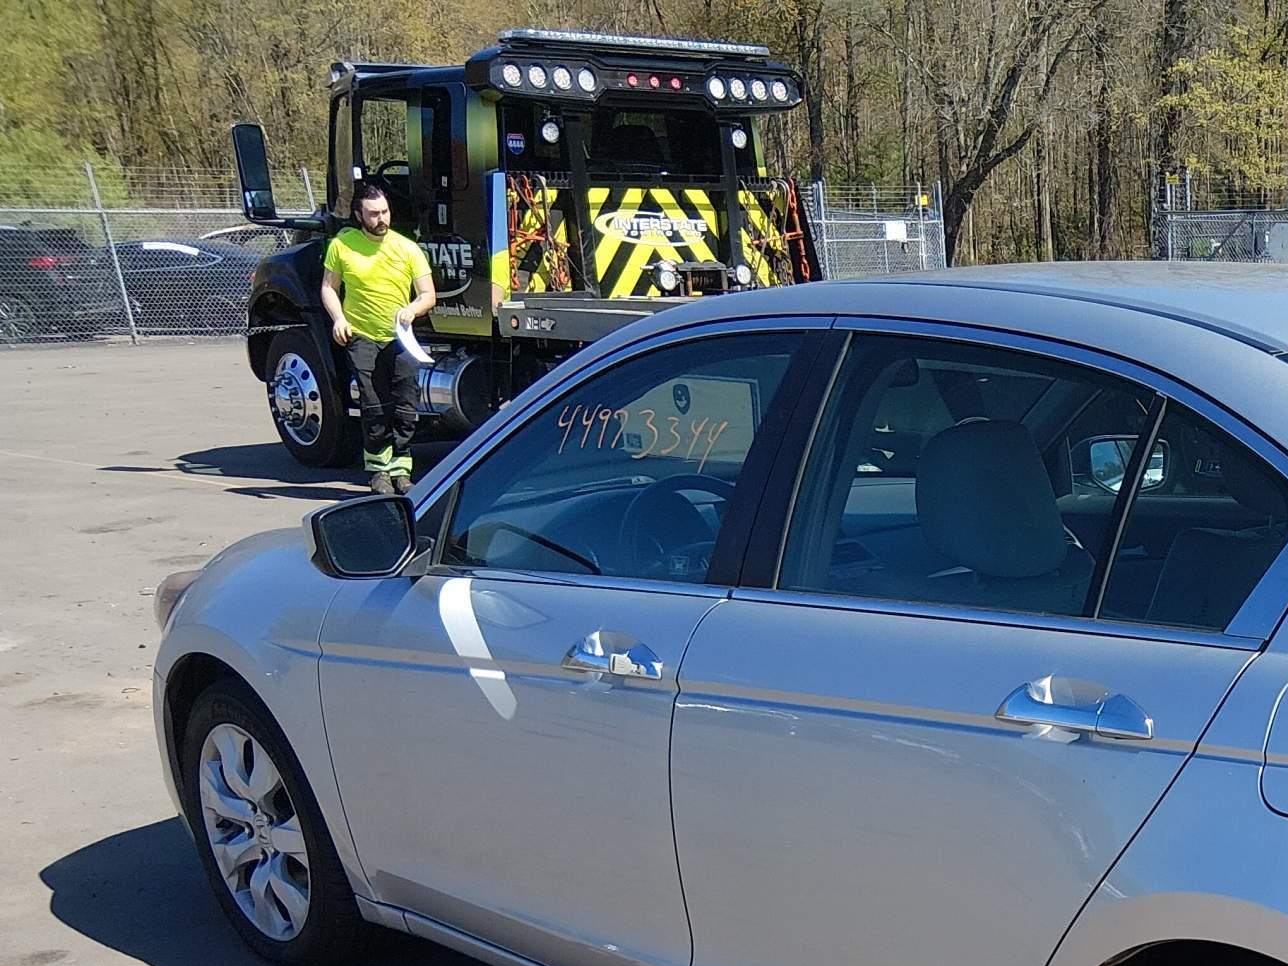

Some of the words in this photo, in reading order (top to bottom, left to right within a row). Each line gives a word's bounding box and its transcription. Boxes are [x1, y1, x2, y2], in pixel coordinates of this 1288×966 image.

[613, 217, 708, 232] INTERSTATE
[441, 268, 467, 279] INC
[557, 403, 728, 474] 44973344
